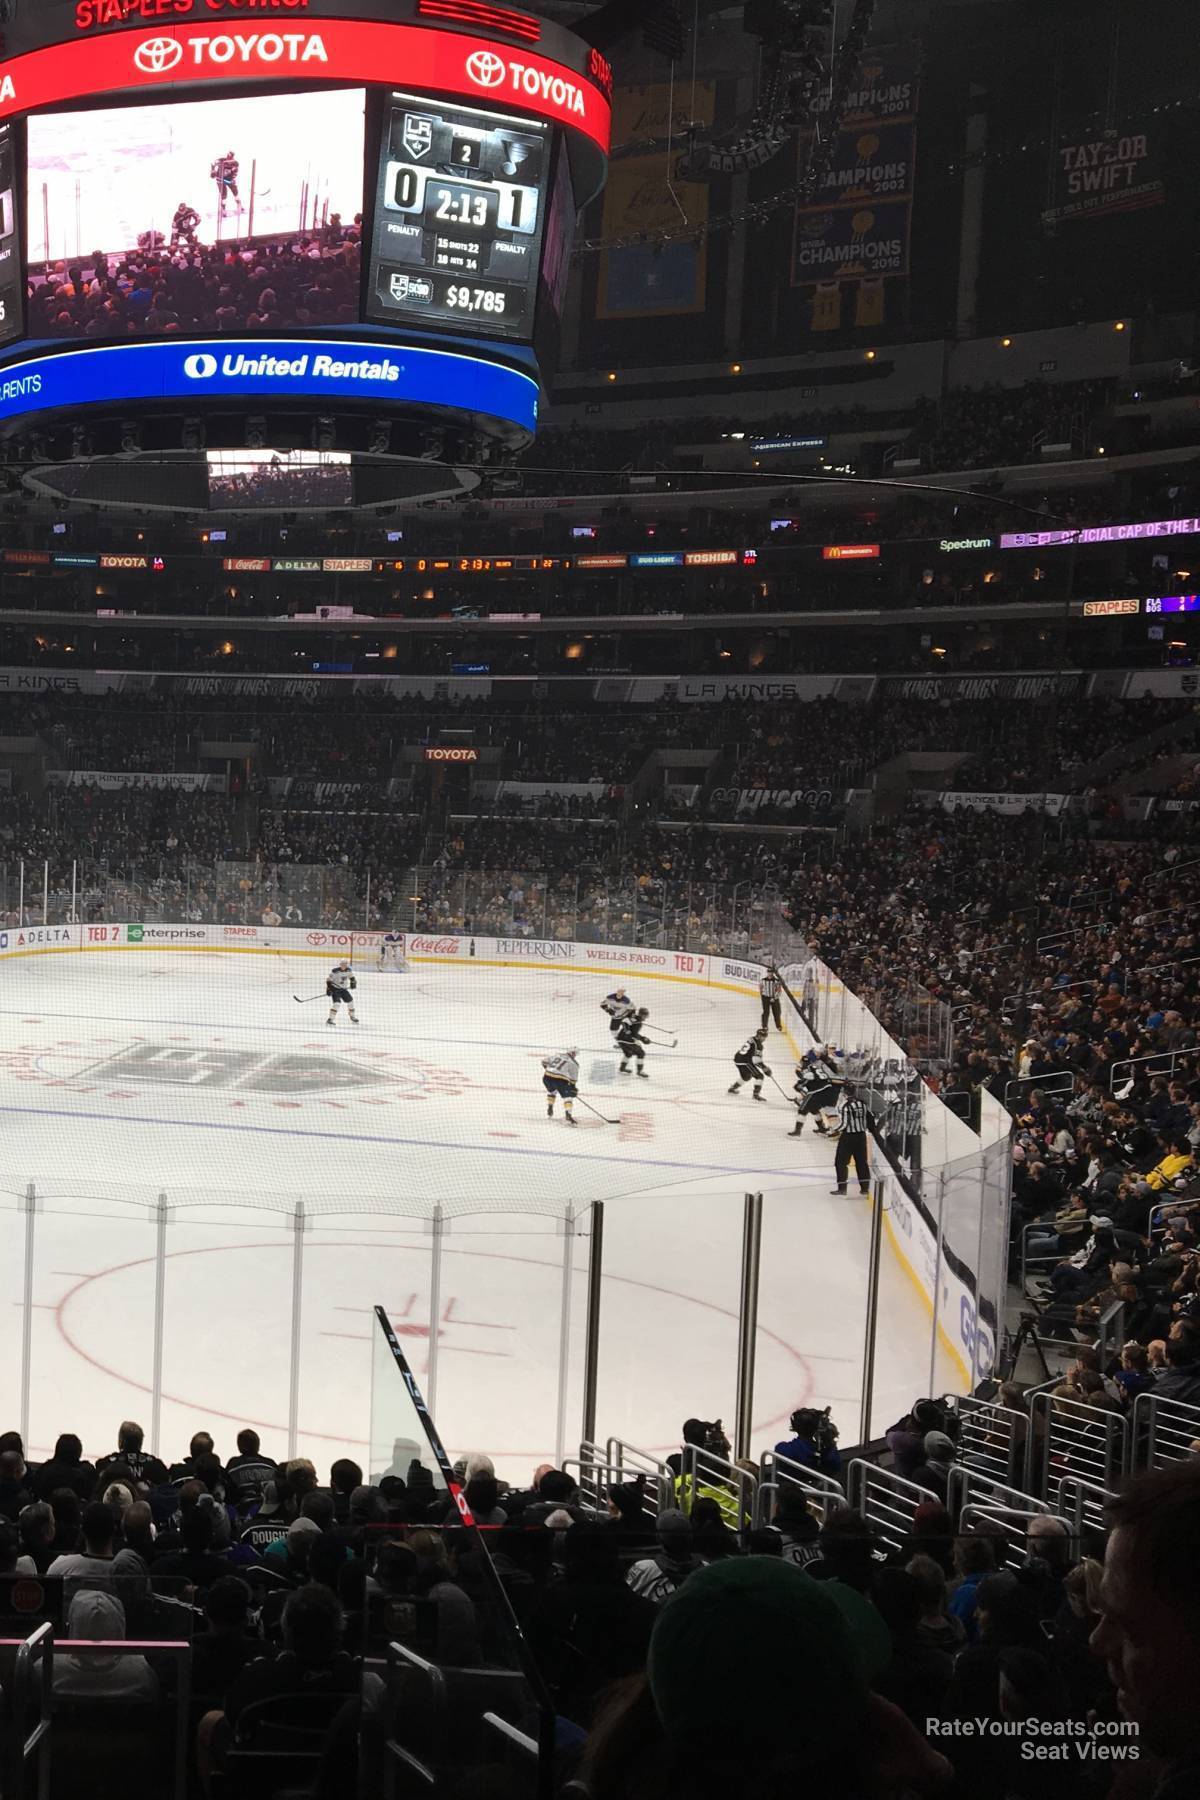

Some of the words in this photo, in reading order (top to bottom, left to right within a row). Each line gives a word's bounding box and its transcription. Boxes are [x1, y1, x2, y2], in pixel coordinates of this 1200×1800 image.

[188, 35, 328, 64] TOYOTA
[509, 62, 585, 116] TOYOTA
[461, 144, 471, 163] 2
[1060, 134, 1148, 170] TAYLOR
[1068, 162, 1137, 193] SWIFT
[395, 167, 418, 208] 0
[435, 189, 487, 226] 2:13
[511, 190, 524, 228] 1
[387, 223, 420, 237] PENALTY
[495, 242, 527, 256] PENALTY
[800, 239, 903, 266] CHAMPIONS
[447, 284, 506, 313] $9,785
[224, 354, 304, 379] United
[313, 354, 398, 382] Rentals
[1118, 525, 1141, 540] CAP
[1147, 524, 1161, 536] OF
[1165, 520, 1189, 534] THE
[940, 538, 991, 553] Spectrum
[101, 556, 147, 567] TOYOTA
[285, 561, 320, 570] DELTA
[323, 559, 371, 571] STAPLES
[460, 559, 482, 570] 2:13
[686, 552, 736, 565] TOSHIBA
[1085, 601, 1138, 615] STAPLES
[1145, 598, 1162, 606] FLA
[18, 675, 80, 690] KINGS
[236, 678, 271, 697] KINGS
[284, 679, 321, 697] KINGS
[685, 683, 717, 698] LA
[726, 683, 797, 698] KINGS
[903, 678, 943, 699] KINGS
[957, 677, 999, 698] KINGS
[425, 749, 477, 760] TOYOTA
[29, 930, 71, 944] DELTA
[88, 927, 107, 941] TED
[111, 927, 120, 941] 7
[131, 927, 205, 940] enterprise
[223, 927, 257, 936] STAPLES
[331, 934, 382, 947] TOYOTA
[410, 935, 461, 954] Coca-Cola
[496, 939, 577, 960] PEPPERDINE
[587, 949, 627, 963] WELLS
[629, 952, 666, 966] FARGO
[674, 954, 693, 972] TED
[697, 956, 705, 974] 7
[724, 963, 742, 979] BUD
[743, 967, 761, 981] LIGHT
